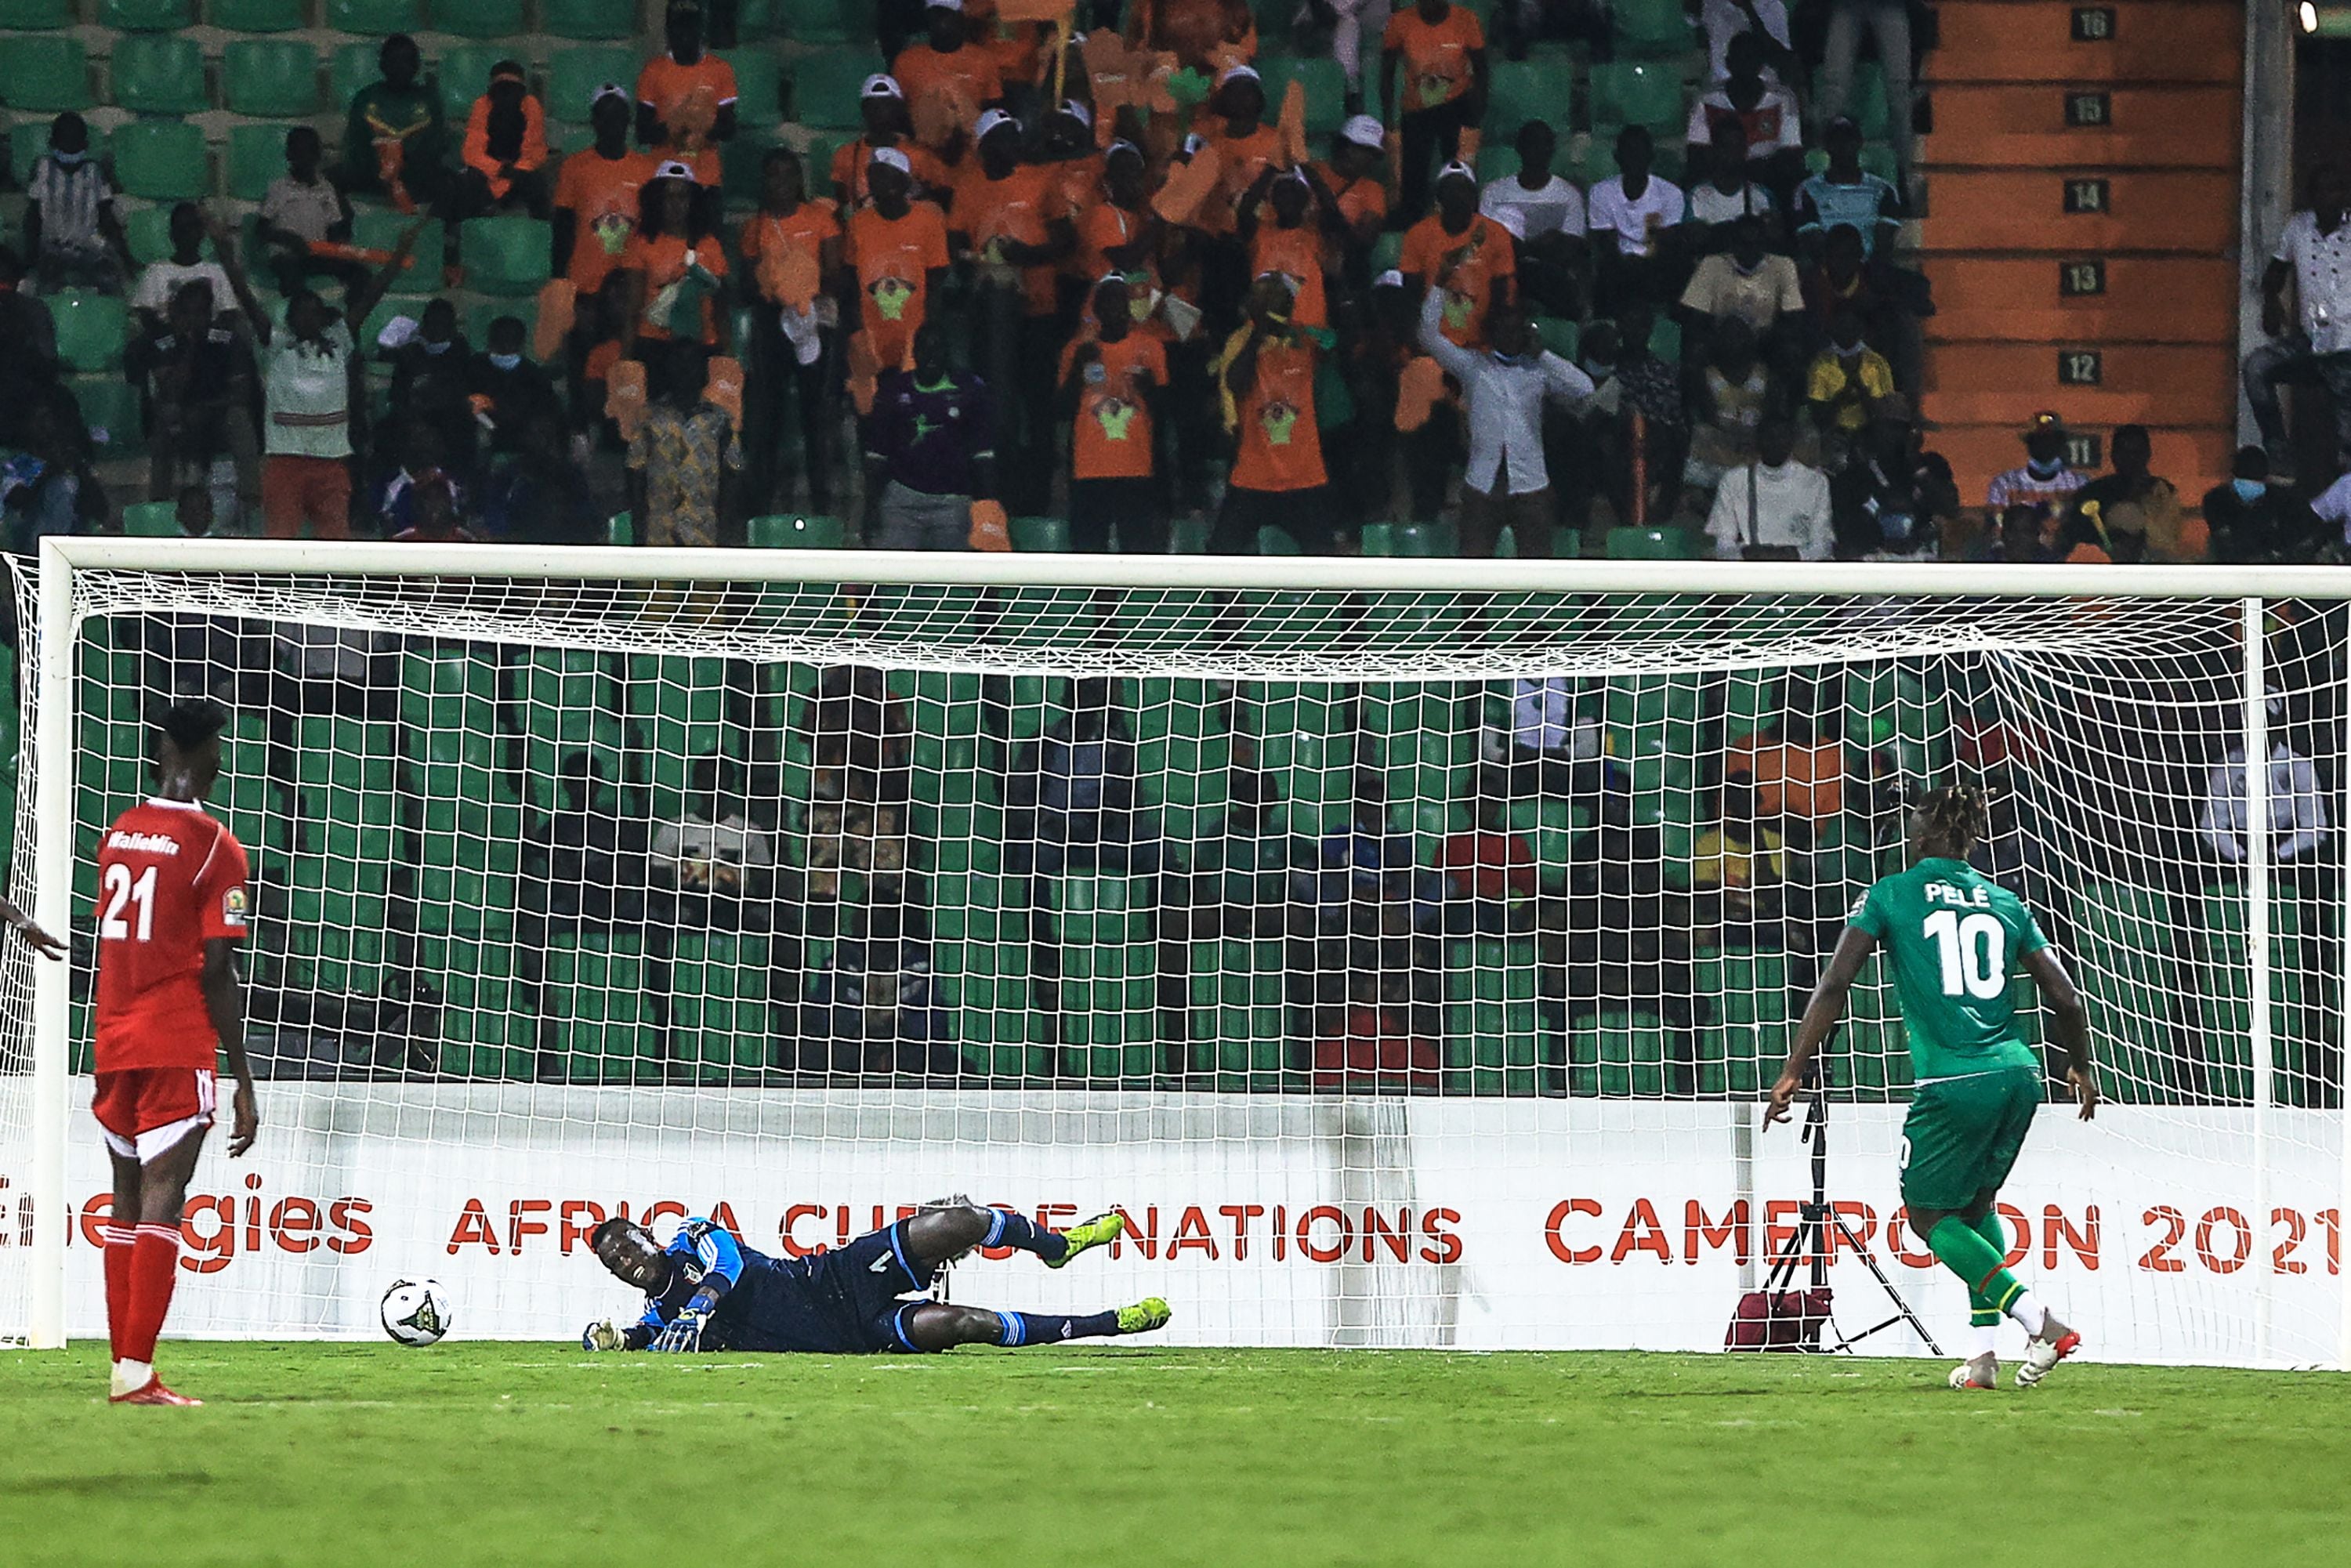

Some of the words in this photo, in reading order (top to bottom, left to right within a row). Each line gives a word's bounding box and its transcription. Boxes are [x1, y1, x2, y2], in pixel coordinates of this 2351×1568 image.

[2074, 182, 2099, 209] 14
[2070, 266, 2096, 291] 13
[2070, 355, 2094, 382] 12
[2067, 439, 2089, 464] 11
[101, 863, 158, 942] 21
[1924, 883, 1991, 907] PELÉ
[1922, 909, 2006, 1000] 10
[446, 1198, 746, 1256] AFRCA
[779, 1203, 918, 1258] CU
[1109, 1203, 1463, 1264] NATIONS
[2138, 1204, 2340, 1276] 2021
